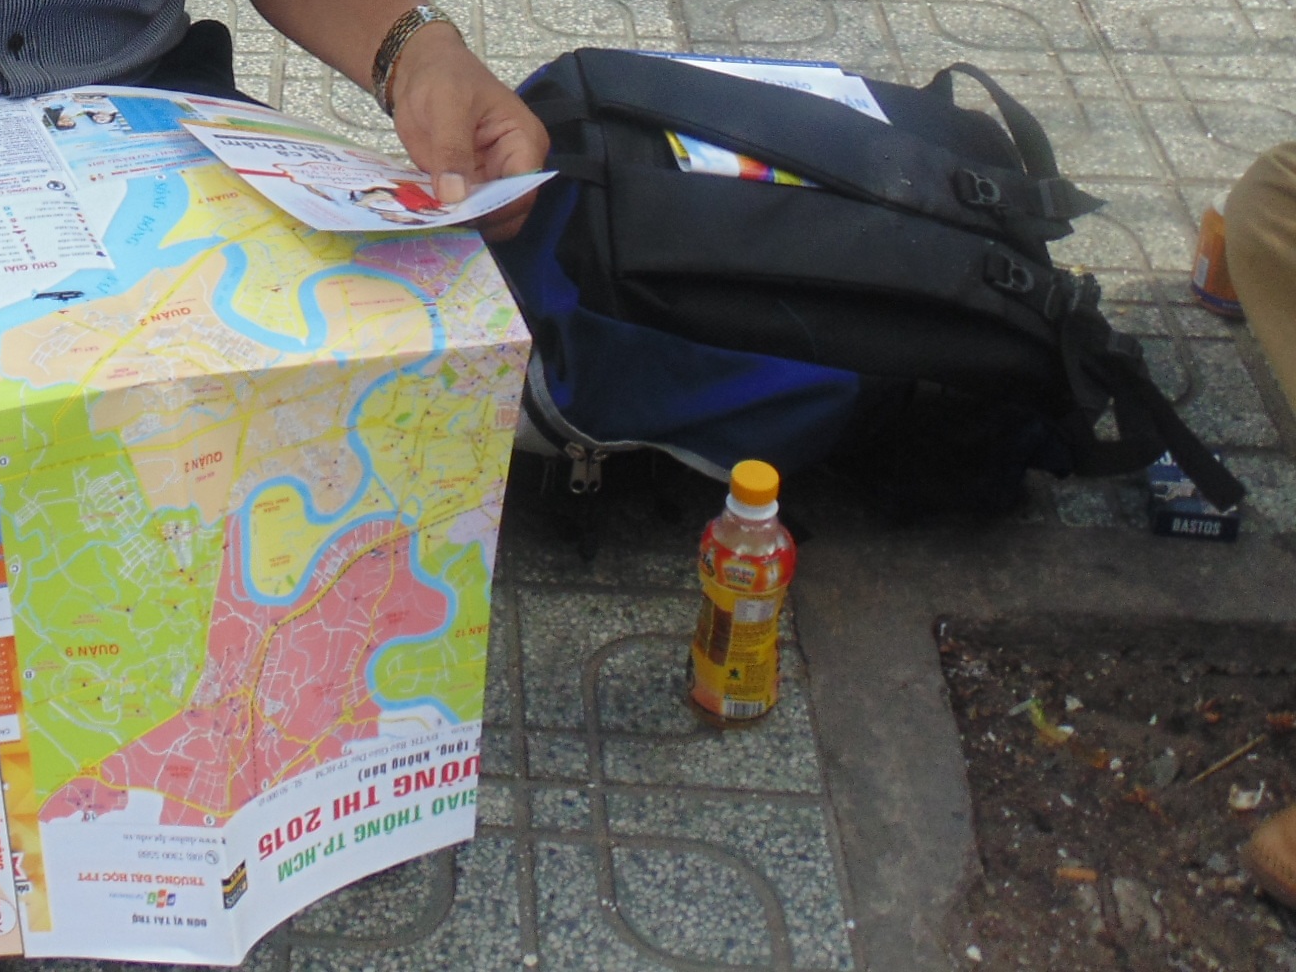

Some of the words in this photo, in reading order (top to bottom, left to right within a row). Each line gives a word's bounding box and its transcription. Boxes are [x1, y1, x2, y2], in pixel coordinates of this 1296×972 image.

[32, 261, 57, 272] CHÚ
[150, 306, 191, 321] QUẬN
[138, 317, 147, 326] 2
[192, 450, 223, 469] QUẬN
[1172, 518, 1221, 536] BASTOS
[65, 646, 73, 656] 9
[81, 644, 120, 656] QUẬN
[391, 751, 430, 770] không
[358, 763, 386, 782] bán)
[333, 785, 380, 820] THI
[431, 789, 477, 816] GIAO
[353, 804, 422, 843] THÔNG
[258, 806, 321, 860] 2015
[278, 833, 346, 883] TP.HCM
[78, 872, 99, 882] FPT
[103, 871, 128, 883] HỌC
[131, 872, 152, 885] ĐẠI
[157, 873, 205, 888] TRƯỜNG
[132, 914, 151, 926] TRỢ
[173, 915, 183, 926] VỊ
